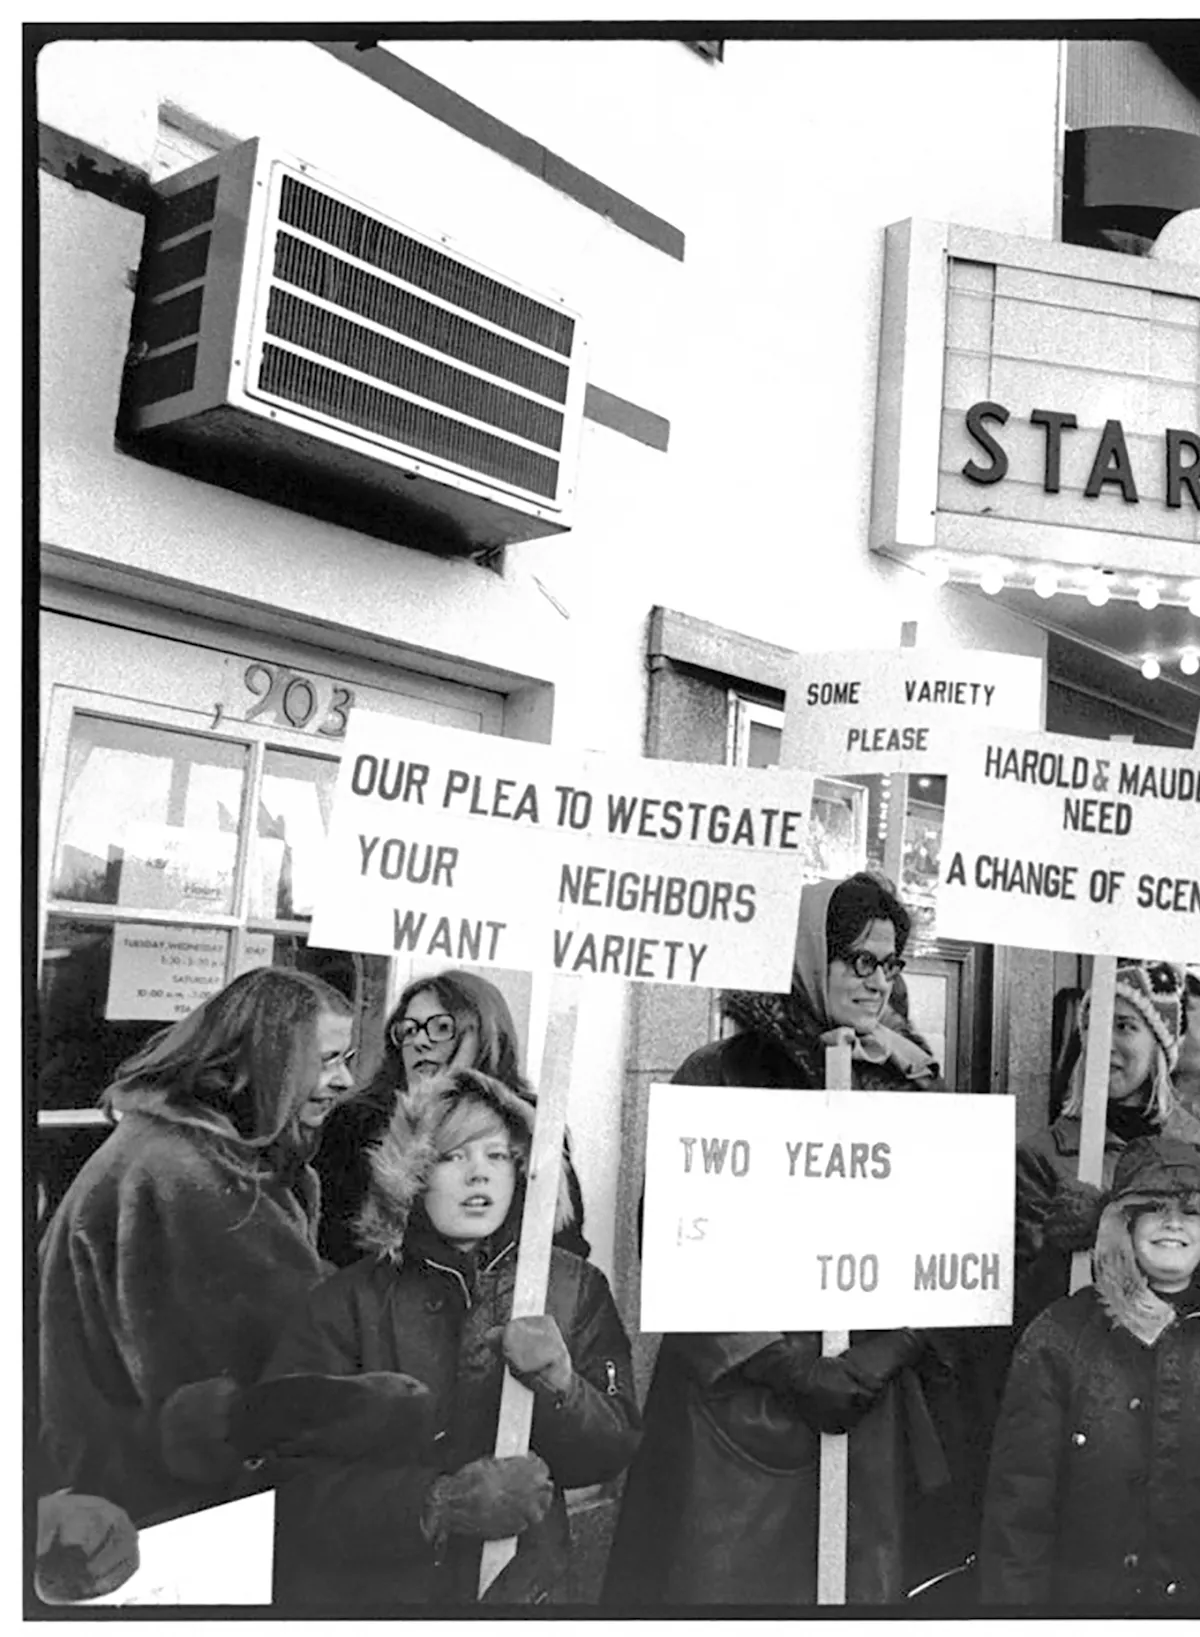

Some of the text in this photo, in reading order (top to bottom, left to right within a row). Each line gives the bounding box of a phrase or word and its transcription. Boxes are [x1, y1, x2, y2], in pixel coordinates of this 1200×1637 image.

[244, 663, 356, 737] 903
[807, 681, 994, 706] SOME VARIETY
[848, 728, 928, 751] PLEASE
[985, 746, 1088, 789] HAROLD
[352, 755, 801, 848] OUR PLEA TO WESTGATE
[1064, 798, 1132, 835] NEED
[360, 836, 755, 922] YOUR NEIGHBORS
[946, 853, 965, 885] A
[976, 855, 1077, 899] CHANGE
[1090, 870, 1125, 903] OF
[395, 910, 706, 981] WANT VARIETY
[679, 1137, 891, 1179] TWO YEARS
[676, 1217, 709, 1247] IS
[817, 1253, 1000, 1292] TOO MUCH
